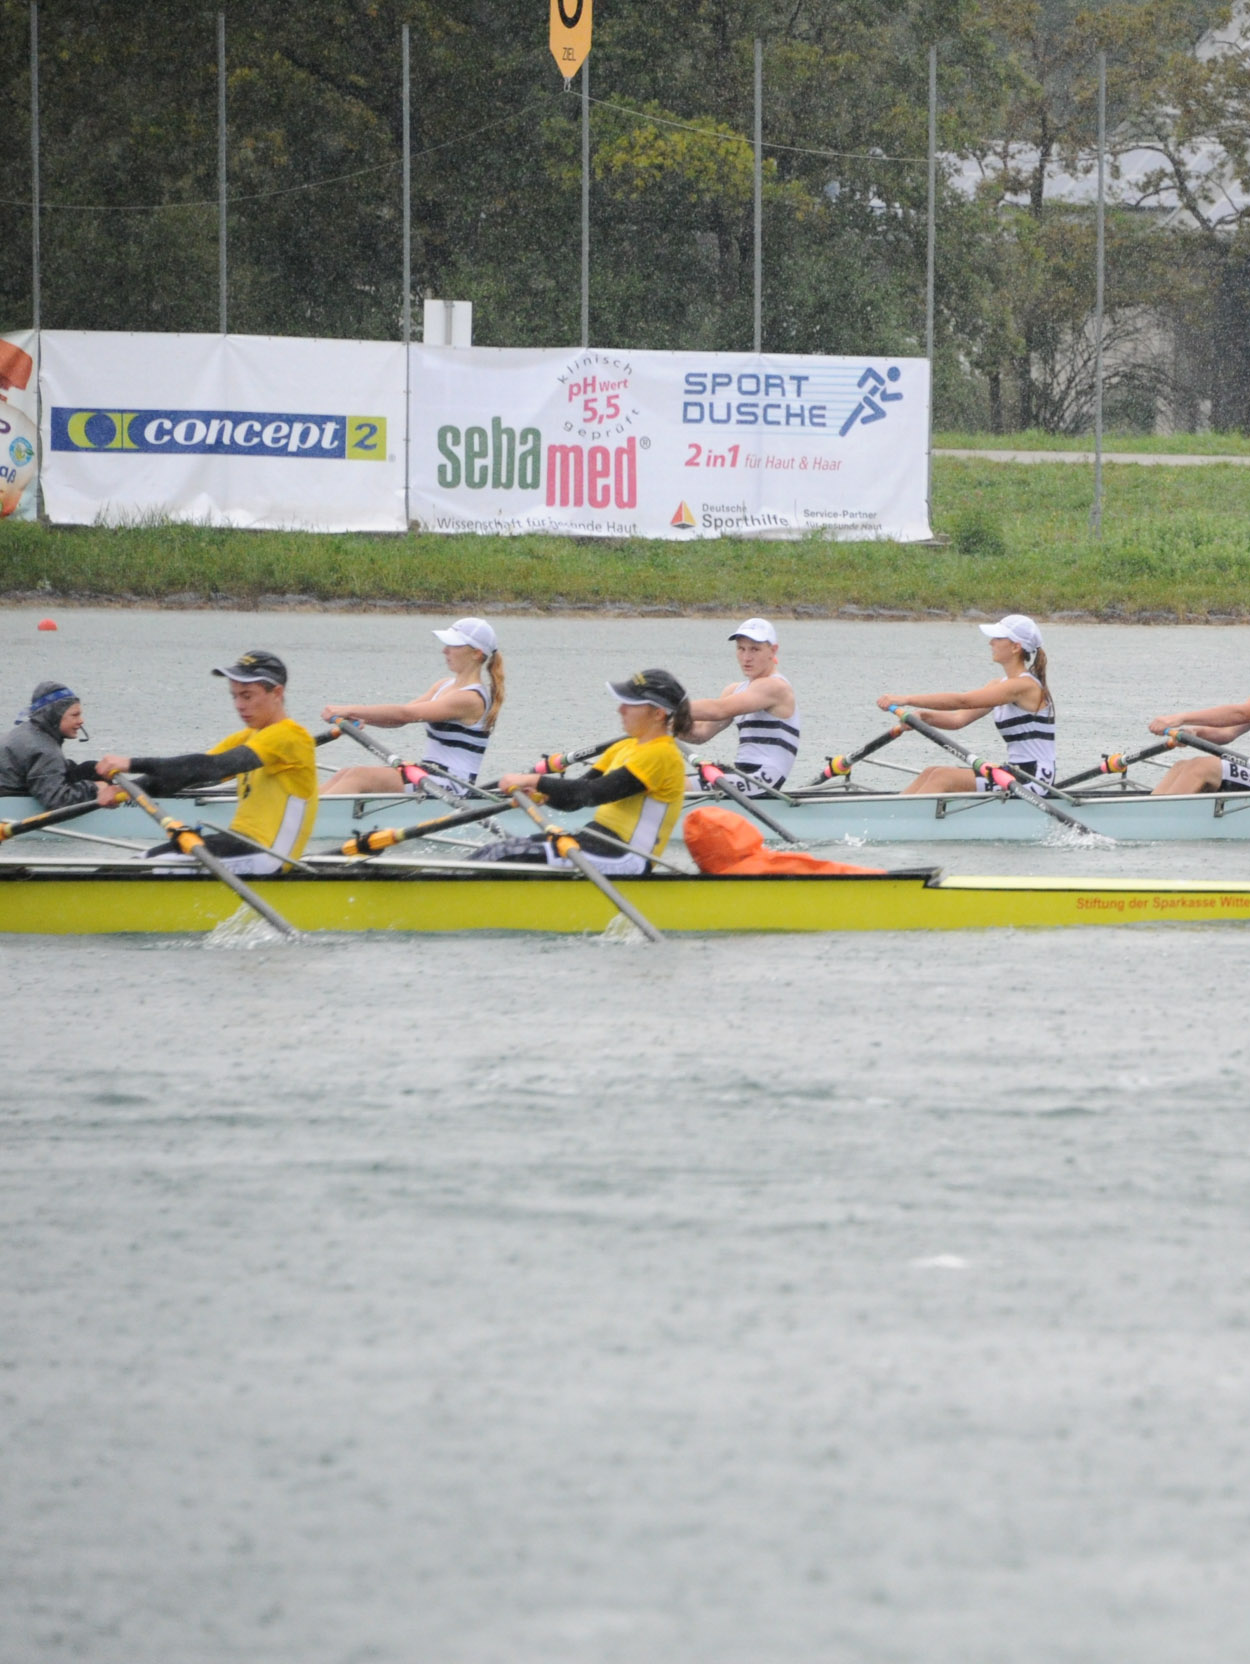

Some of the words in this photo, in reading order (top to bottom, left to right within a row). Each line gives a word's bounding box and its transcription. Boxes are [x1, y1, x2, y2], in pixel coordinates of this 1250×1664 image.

[562, 47, 577, 61] ZIEL
[557, 354, 633, 384] klinisch
[568, 375, 597, 402] pH
[599, 378, 629, 392] Wert
[684, 372, 809, 397] SPORT
[582, 394, 621, 424] 5,5
[682, 402, 827, 427] DUSCHE
[144, 418, 339, 452] concept
[351, 423, 379, 450] 2
[563, 408, 640, 440] geprüft
[744, 453, 762, 469] für
[765, 455, 795, 470] Haut
[798, 455, 808, 470] &
[812, 456, 842, 471] Haar
[702, 503, 747, 513] Deutsche
[803, 508, 878, 519] Service-Partner
[437, 516, 522, 531] Wissenschaft
[606, 520, 638, 535] Haut
[702, 513, 789, 529] Sporthilfe
[1077, 897, 1125, 911] Stiftung
[1129, 897, 1148, 909] der
[1152, 896, 1216, 911] Sparkasse
